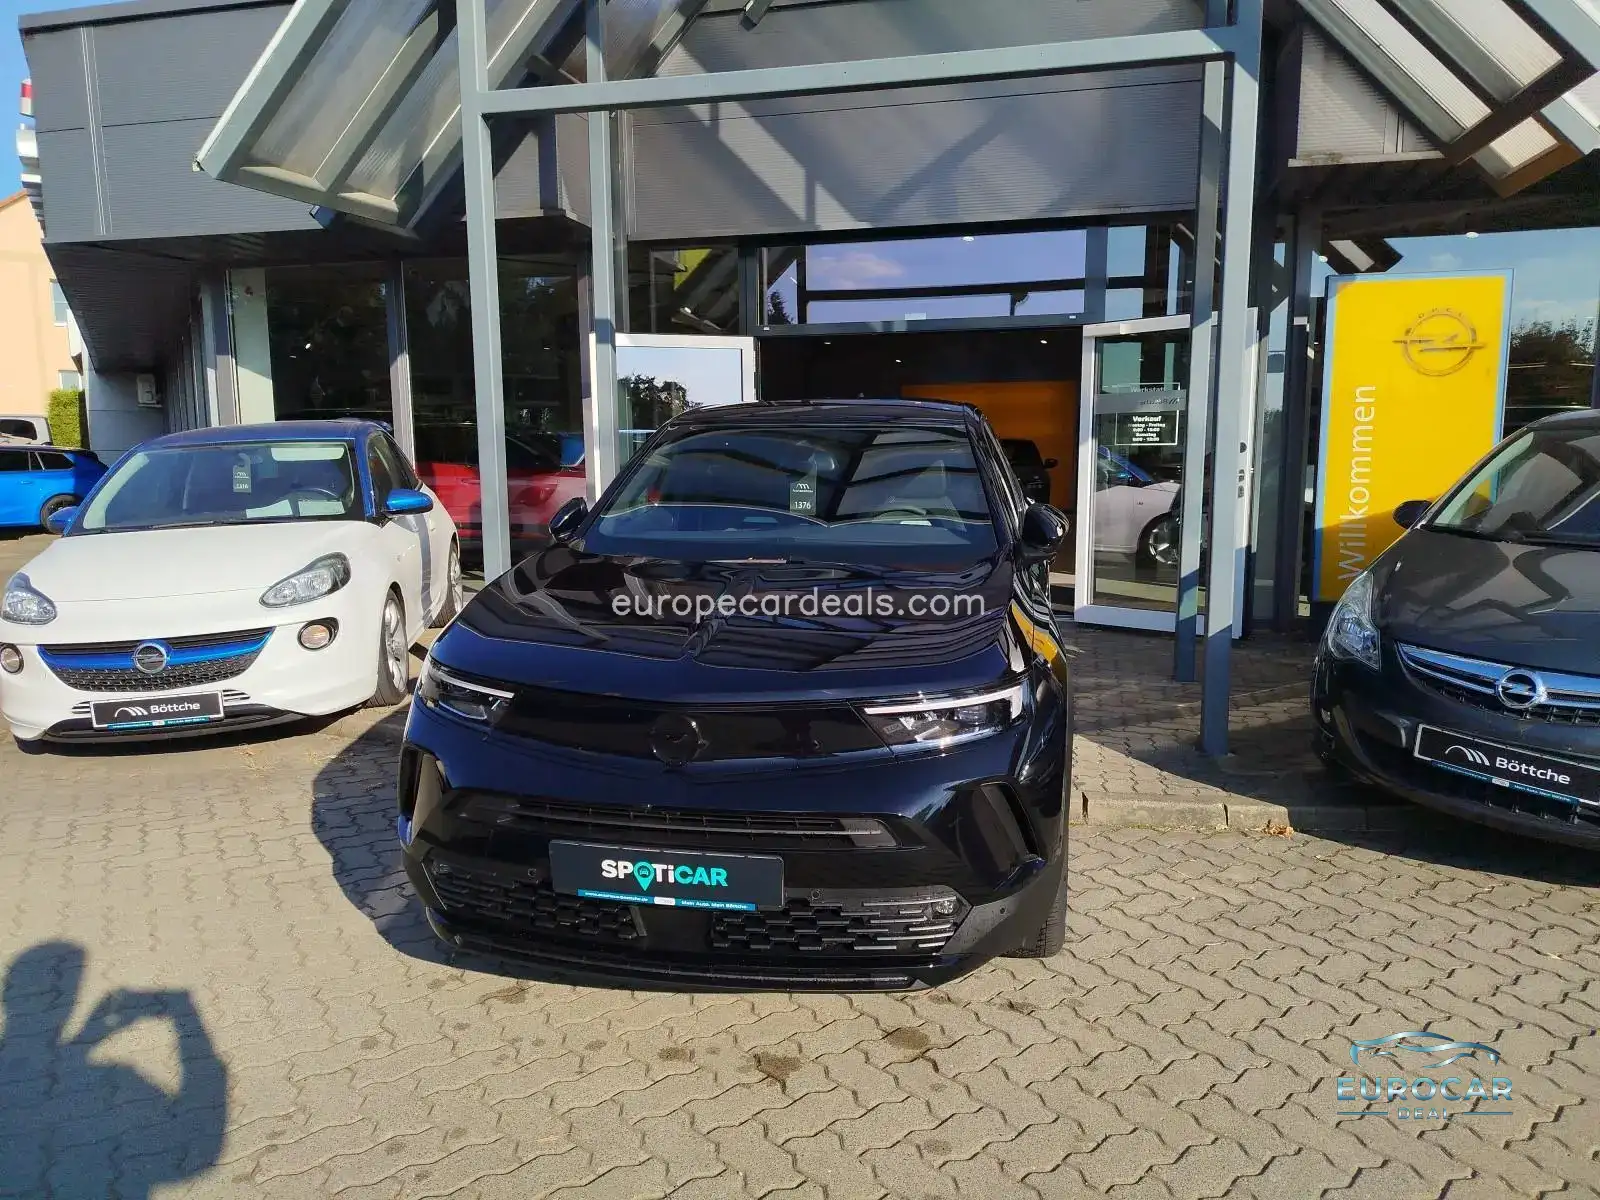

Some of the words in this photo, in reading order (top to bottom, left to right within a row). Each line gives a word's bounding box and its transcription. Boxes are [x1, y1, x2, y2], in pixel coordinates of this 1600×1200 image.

[1338, 384, 1377, 580] Willkommen
[794, 501, 811, 510] 1376
[150, 701, 201, 714] Böttche
[1495, 756, 1572, 785] Böttche
